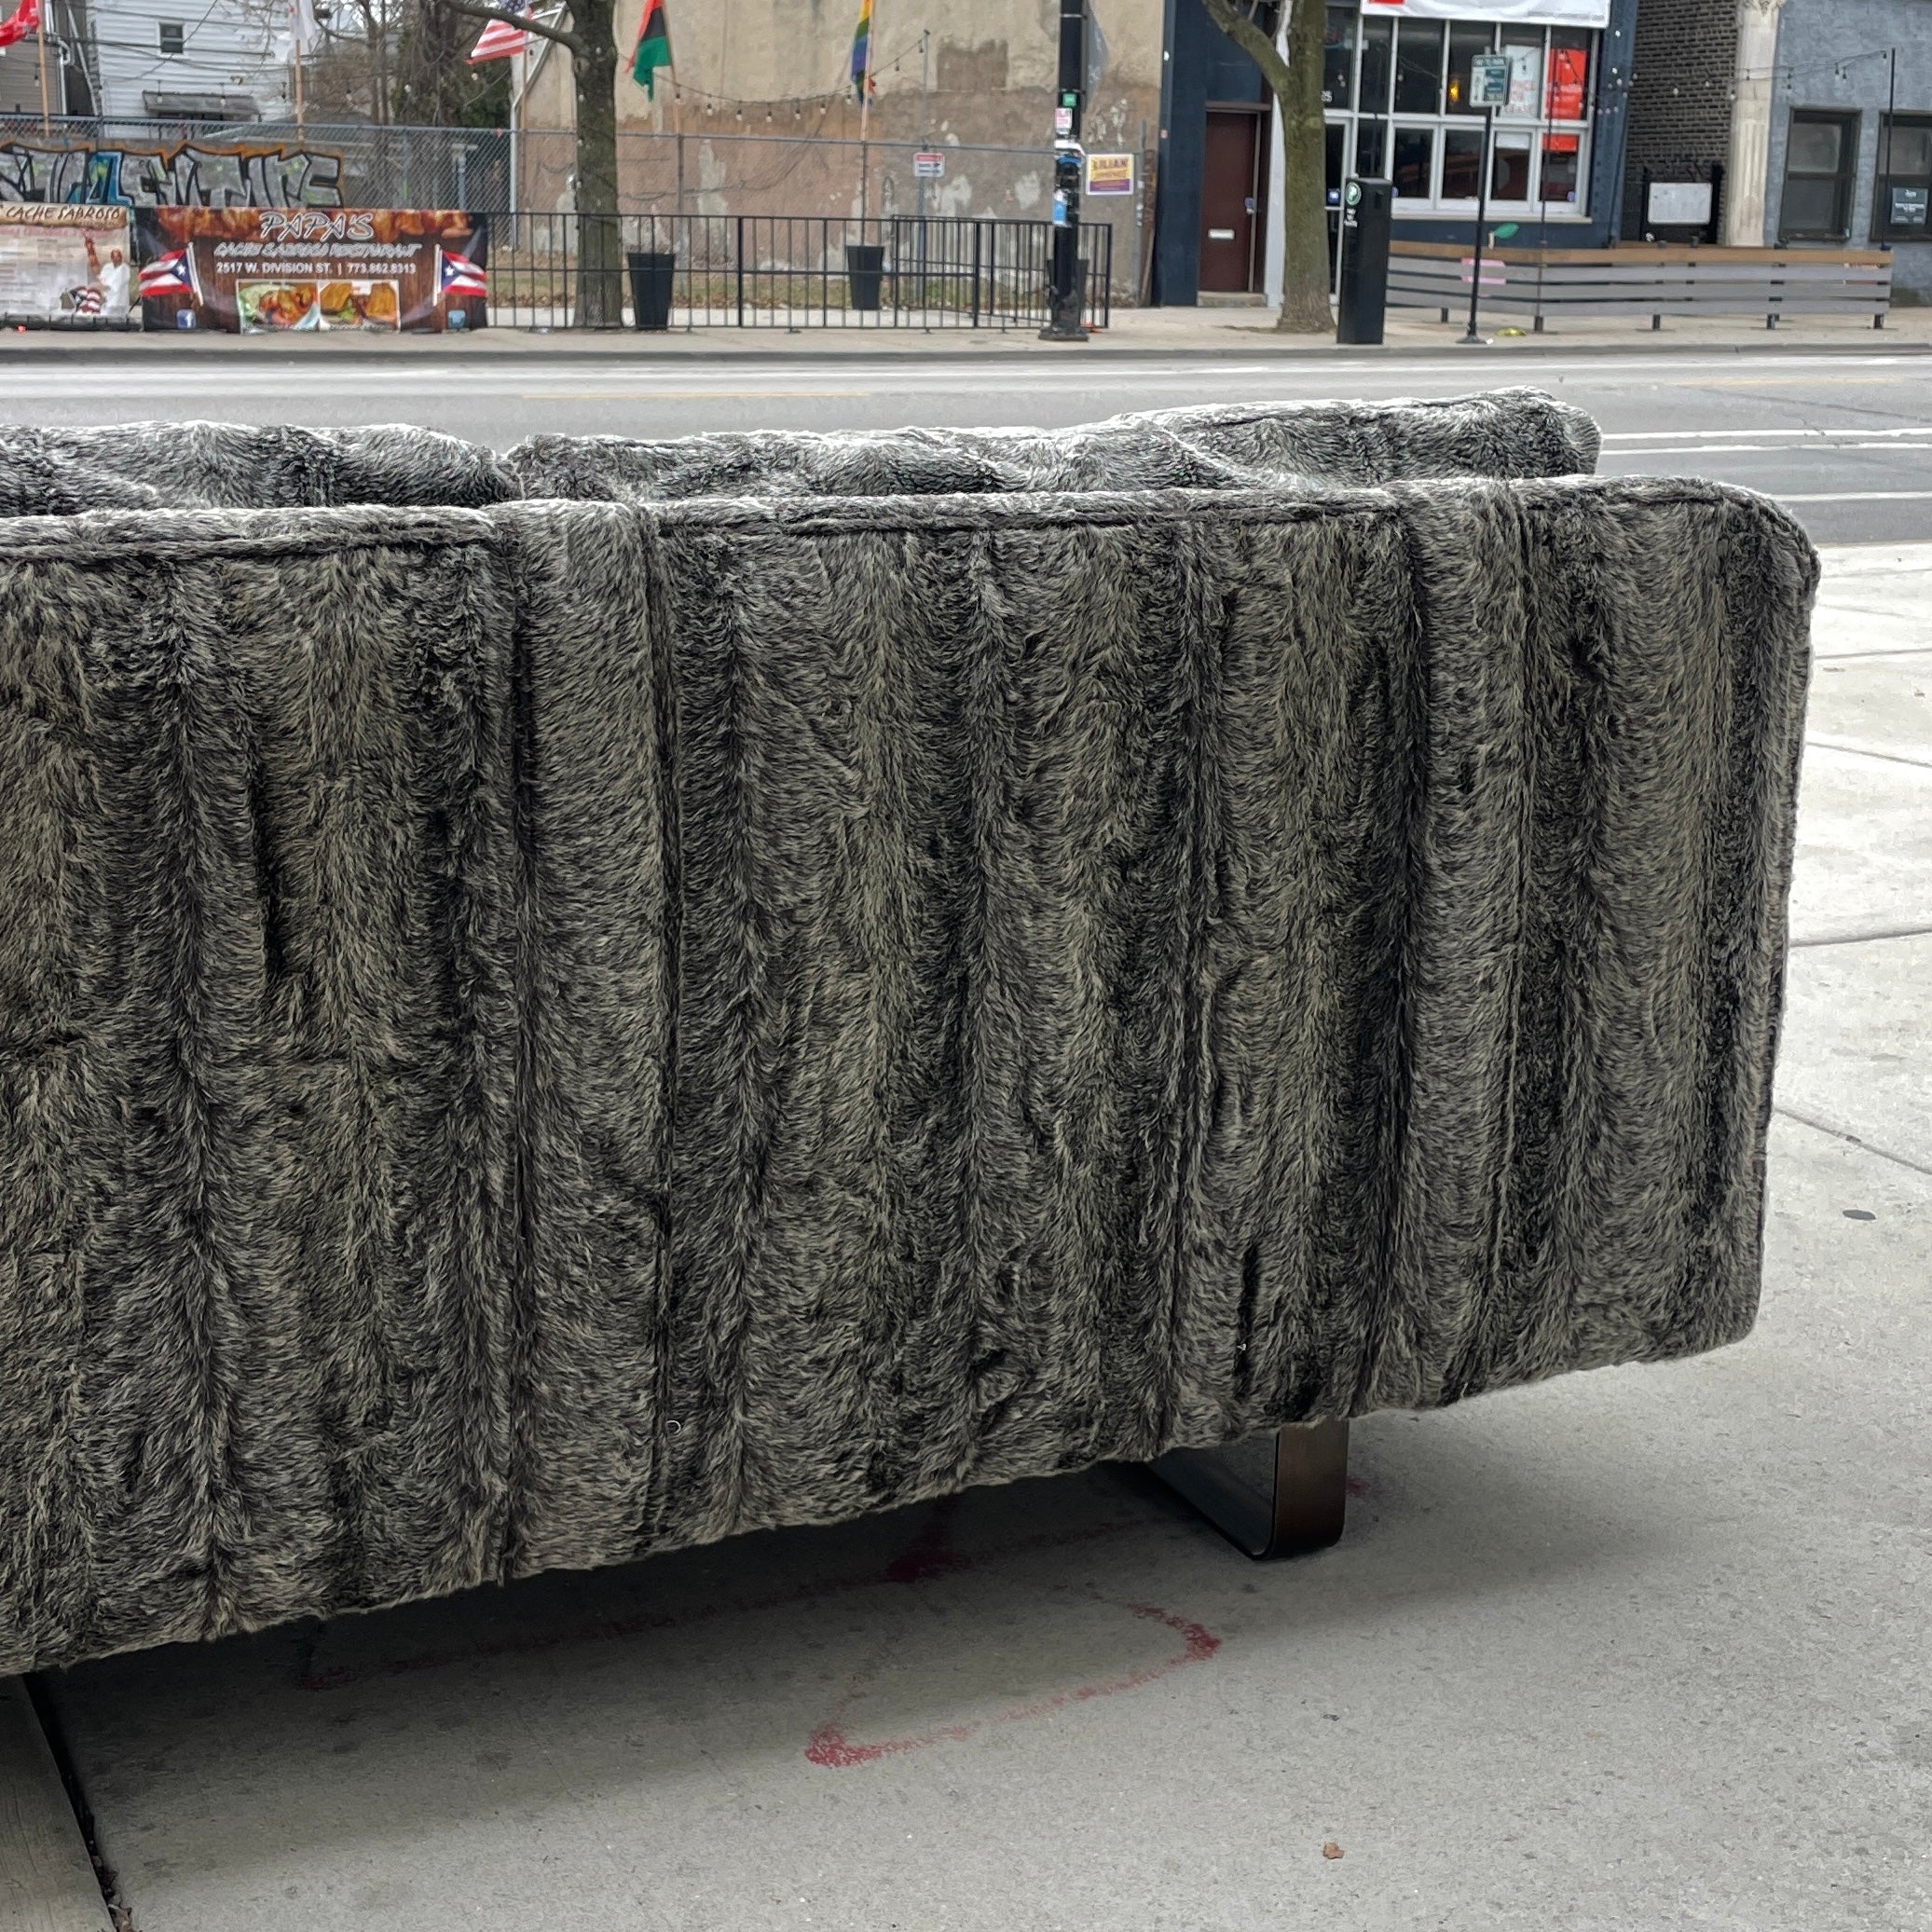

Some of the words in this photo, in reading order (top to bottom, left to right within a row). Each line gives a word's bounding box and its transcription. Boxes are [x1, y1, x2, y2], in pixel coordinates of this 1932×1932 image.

[6, 205, 57, 222] CACHE
[58, 205, 120, 221] SABROSO
[259, 211, 375, 241] PAPA'S
[214, 241, 263, 258] CACHE
[216, 262, 242, 274] 2517
[244, 262, 259, 274] W.
[262, 262, 313, 274] DIVISION
[315, 262, 333, 274] ST.
